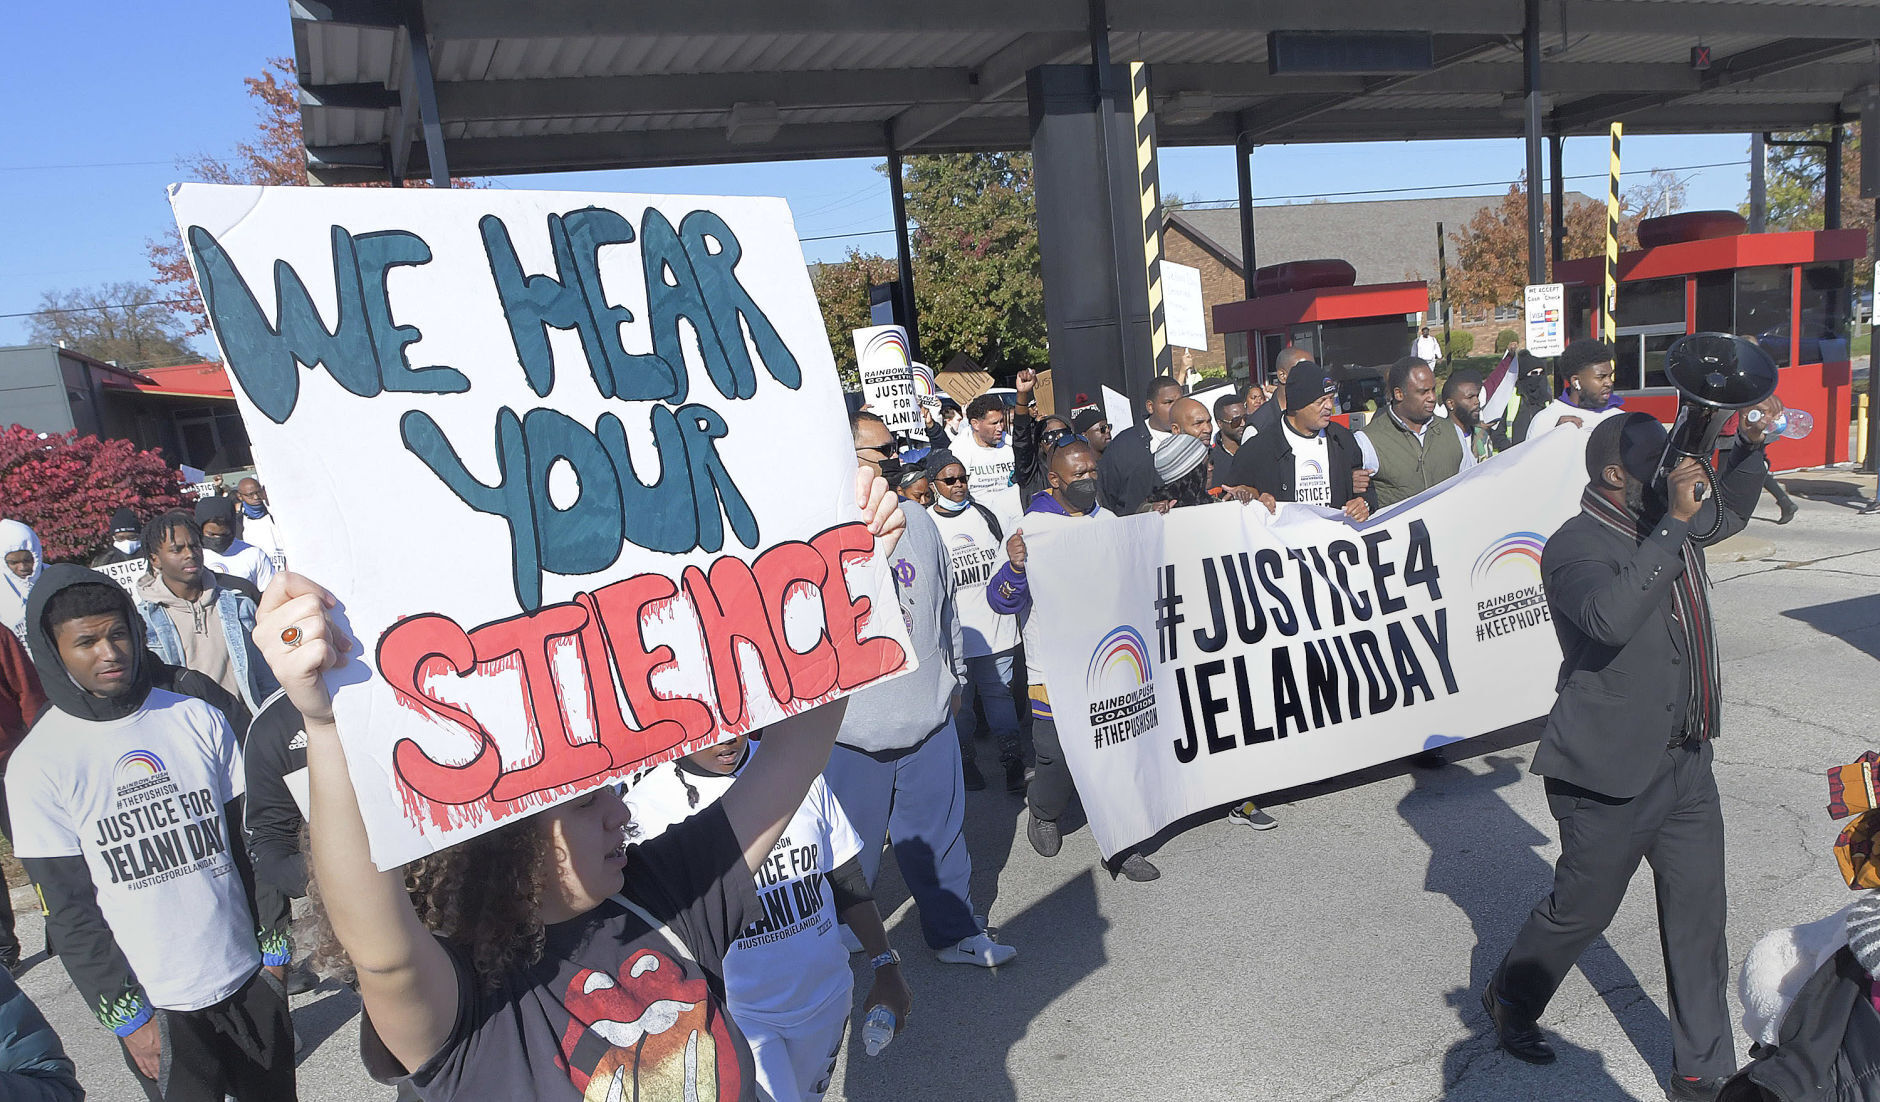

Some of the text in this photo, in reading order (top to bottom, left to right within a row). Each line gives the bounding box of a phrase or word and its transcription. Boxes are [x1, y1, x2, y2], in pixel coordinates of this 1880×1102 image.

[187, 206, 803, 425] WE HEAR
[876, 383, 913, 399] JUSTIC
[893, 398, 911, 409] FOR
[400, 403, 760, 617] YOUR
[952, 548, 997, 569] STICE FOR
[954, 565, 981, 587] LANI
[1154, 518, 1443, 664] #JUSTICE4
[1476, 605, 1550, 643] #KEEPHOPE
[375, 521, 908, 806] SILENCE
[1138, 683, 1154, 699] PUSH
[1173, 607, 1460, 764] JELANIDAY
[1092, 695, 1155, 725] COALITION
[1094, 707, 1159, 750] #THEPUSHISON
[150, 771, 169, 781] PUSH
[116, 782, 180, 810] #THEPUSHISON
[96, 788, 216, 847] JUSTICE FOR
[100, 815, 226, 884] JELANI DAY
[127, 856, 218, 891] #JUSTICEFORJELANIDAY
[791, 871, 824, 920] DAY
[737, 914, 822, 951] #JUSTICEFORJELANIDAY
